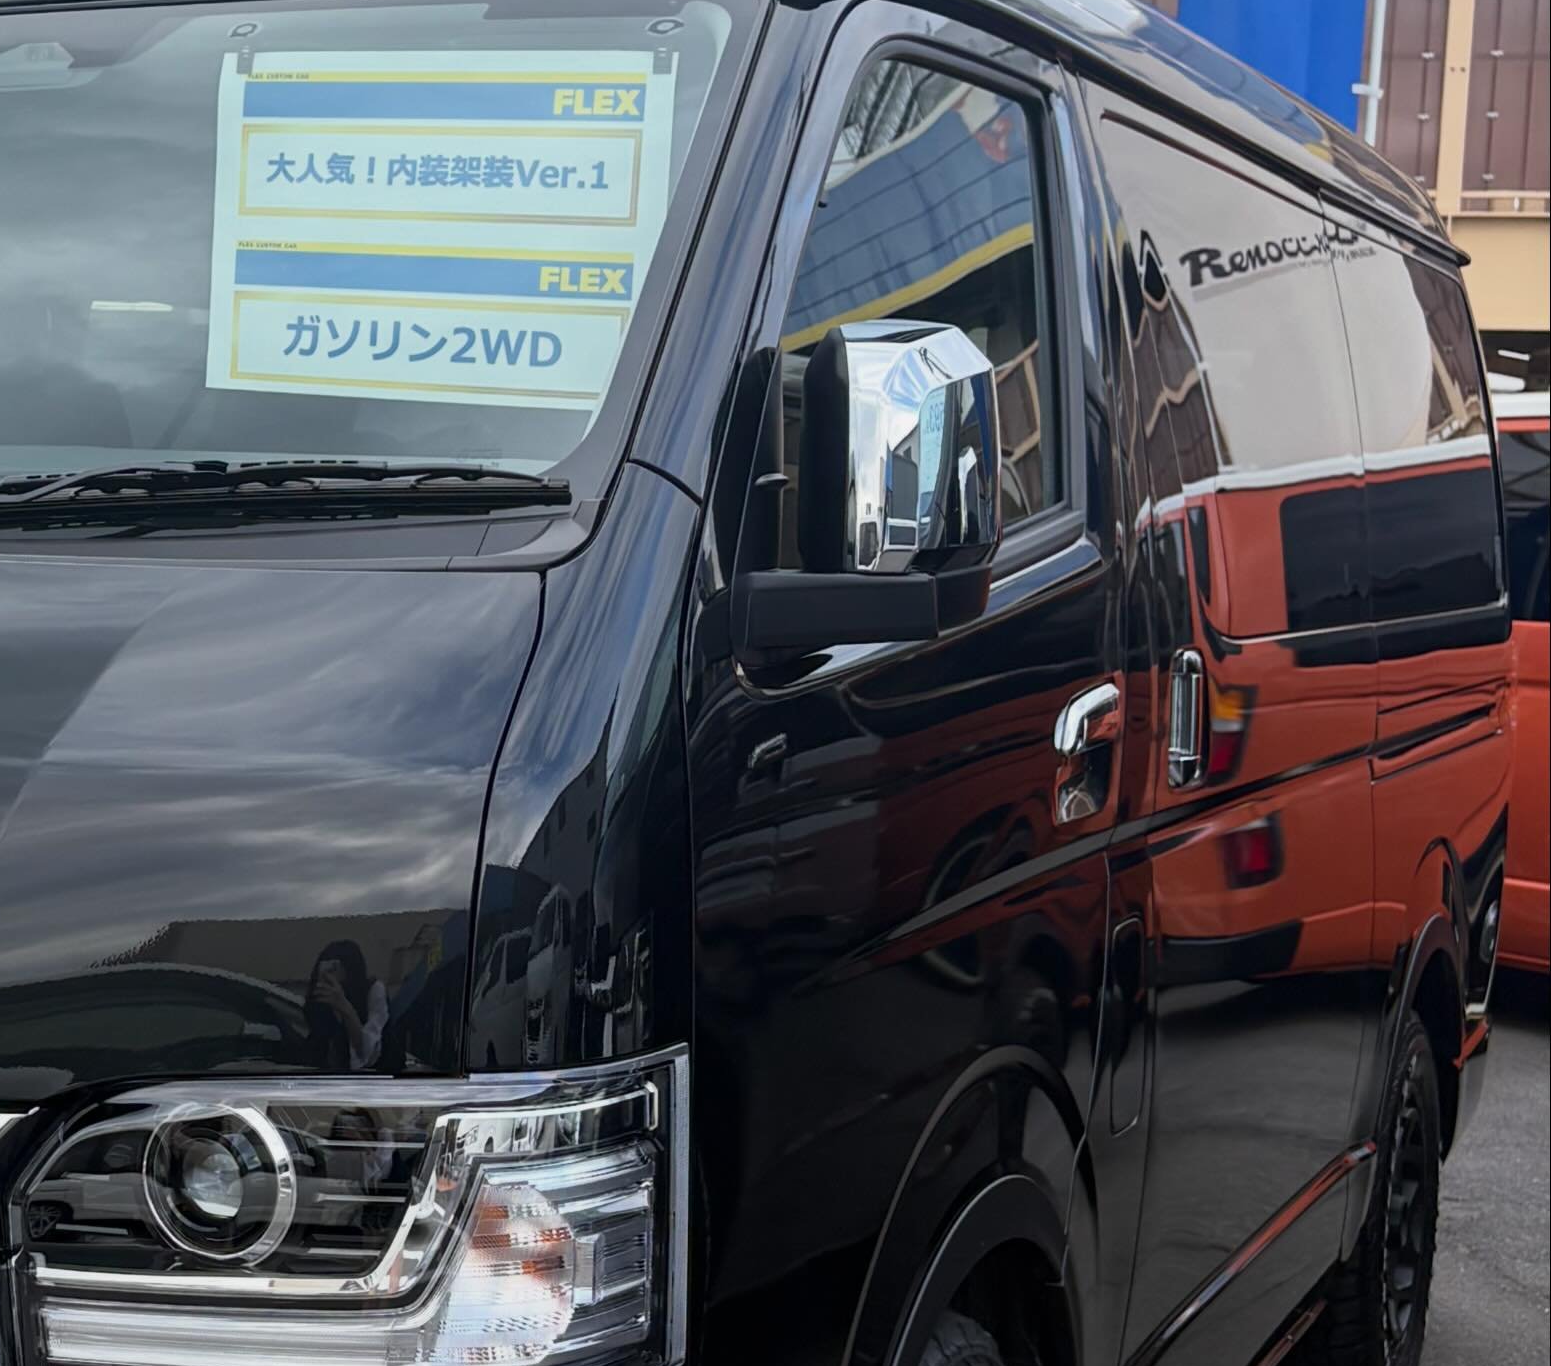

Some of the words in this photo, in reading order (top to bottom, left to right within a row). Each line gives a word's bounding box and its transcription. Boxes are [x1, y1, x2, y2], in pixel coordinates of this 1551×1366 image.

[552, 88, 640, 117] FLEX
[538, 266, 626, 295] FLEX
[282, 316, 563, 368] ガソリン2WD
